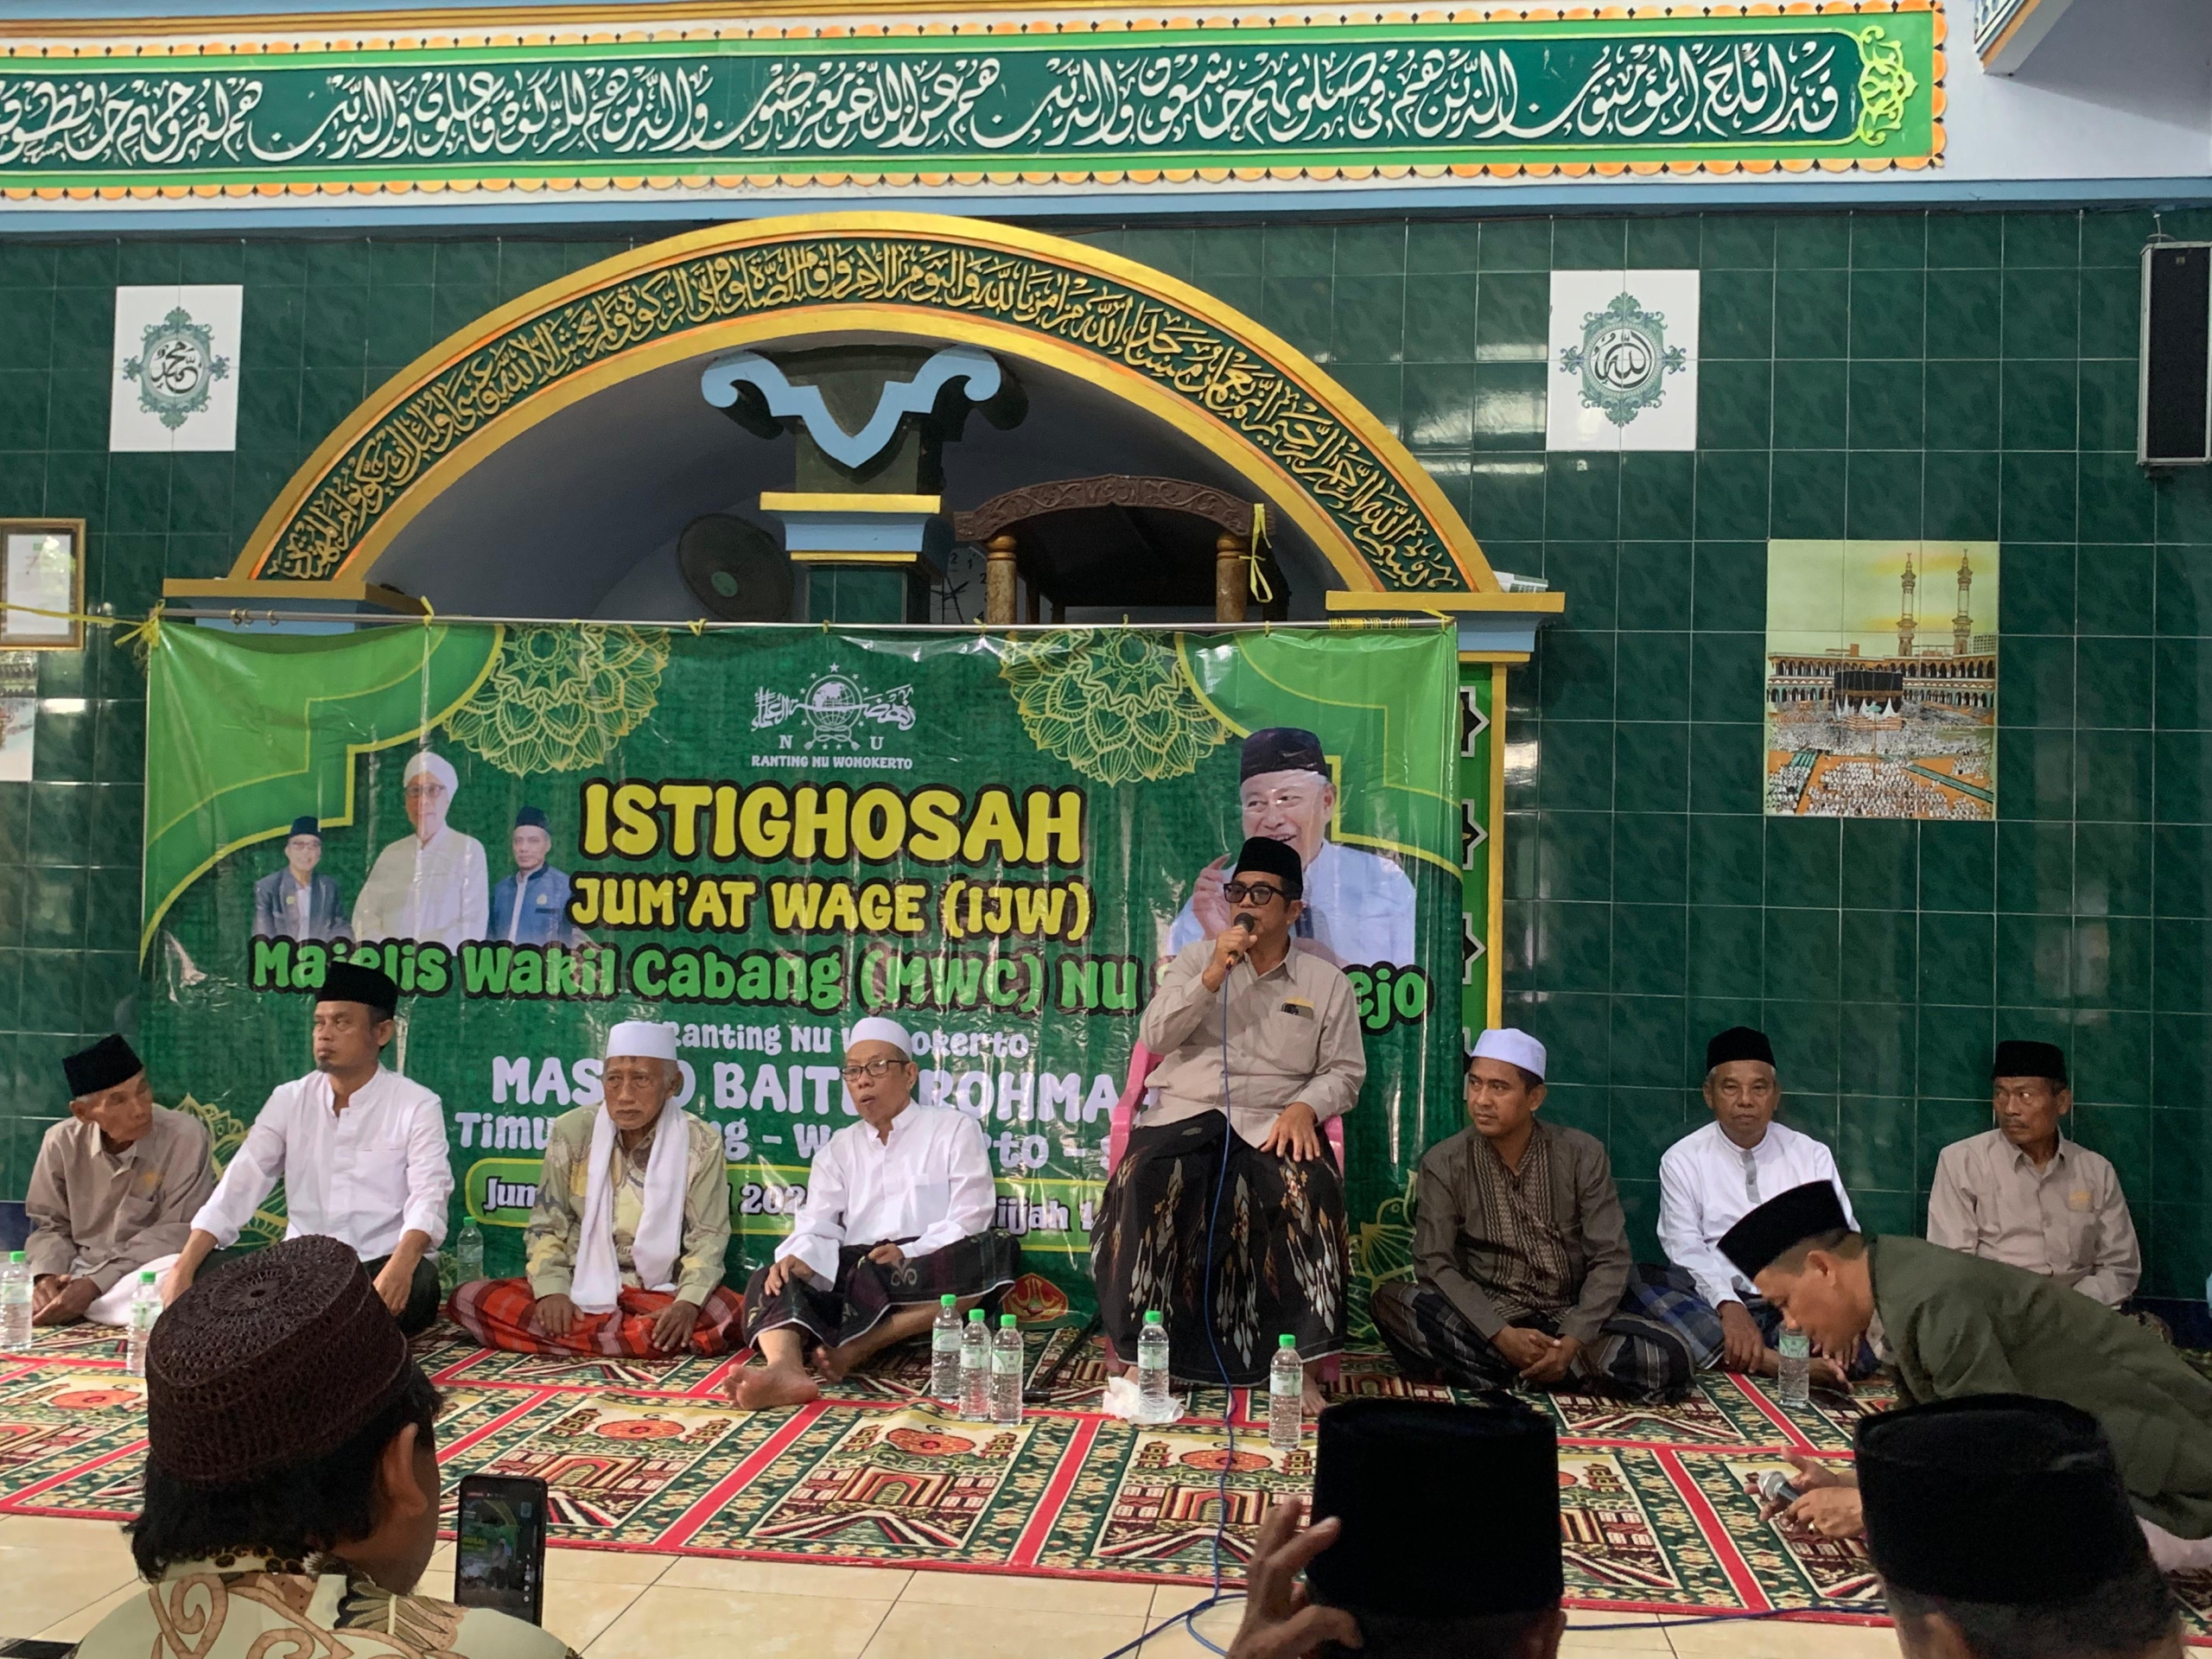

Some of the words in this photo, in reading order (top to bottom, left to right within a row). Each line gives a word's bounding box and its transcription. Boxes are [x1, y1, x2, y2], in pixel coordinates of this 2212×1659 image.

[149, 340, 202, 395] محمد
[1591, 330, 1653, 389] الله
[751, 754, 809, 768] RANTING
[811, 756, 830, 769] NU
[833, 757, 913, 771] WONOKERTO
[779, 734, 794, 750] N
[869, 735, 885, 751] U
[584, 781, 1084, 865] ISTIGHOSAH
[570, 876, 756, 931] JUM'AT
[770, 880, 927, 933] WAGE
[944, 878, 1092, 943] (IJW)
[251, 938, 451, 995] Maelis
[463, 944, 617, 997] Wakil
[632, 950, 842, 1011] Cabang
[860, 949, 1043, 1013] (MWC)
[1060, 959, 1140, 1012] NU
[790, 1025, 832, 1054] NU
[842, 1025, 1030, 1058] okerto
[491, 1055, 696, 1109] MASD
[454, 1111, 557, 1151] Timu
[740, 1184, 809, 1215] 202
